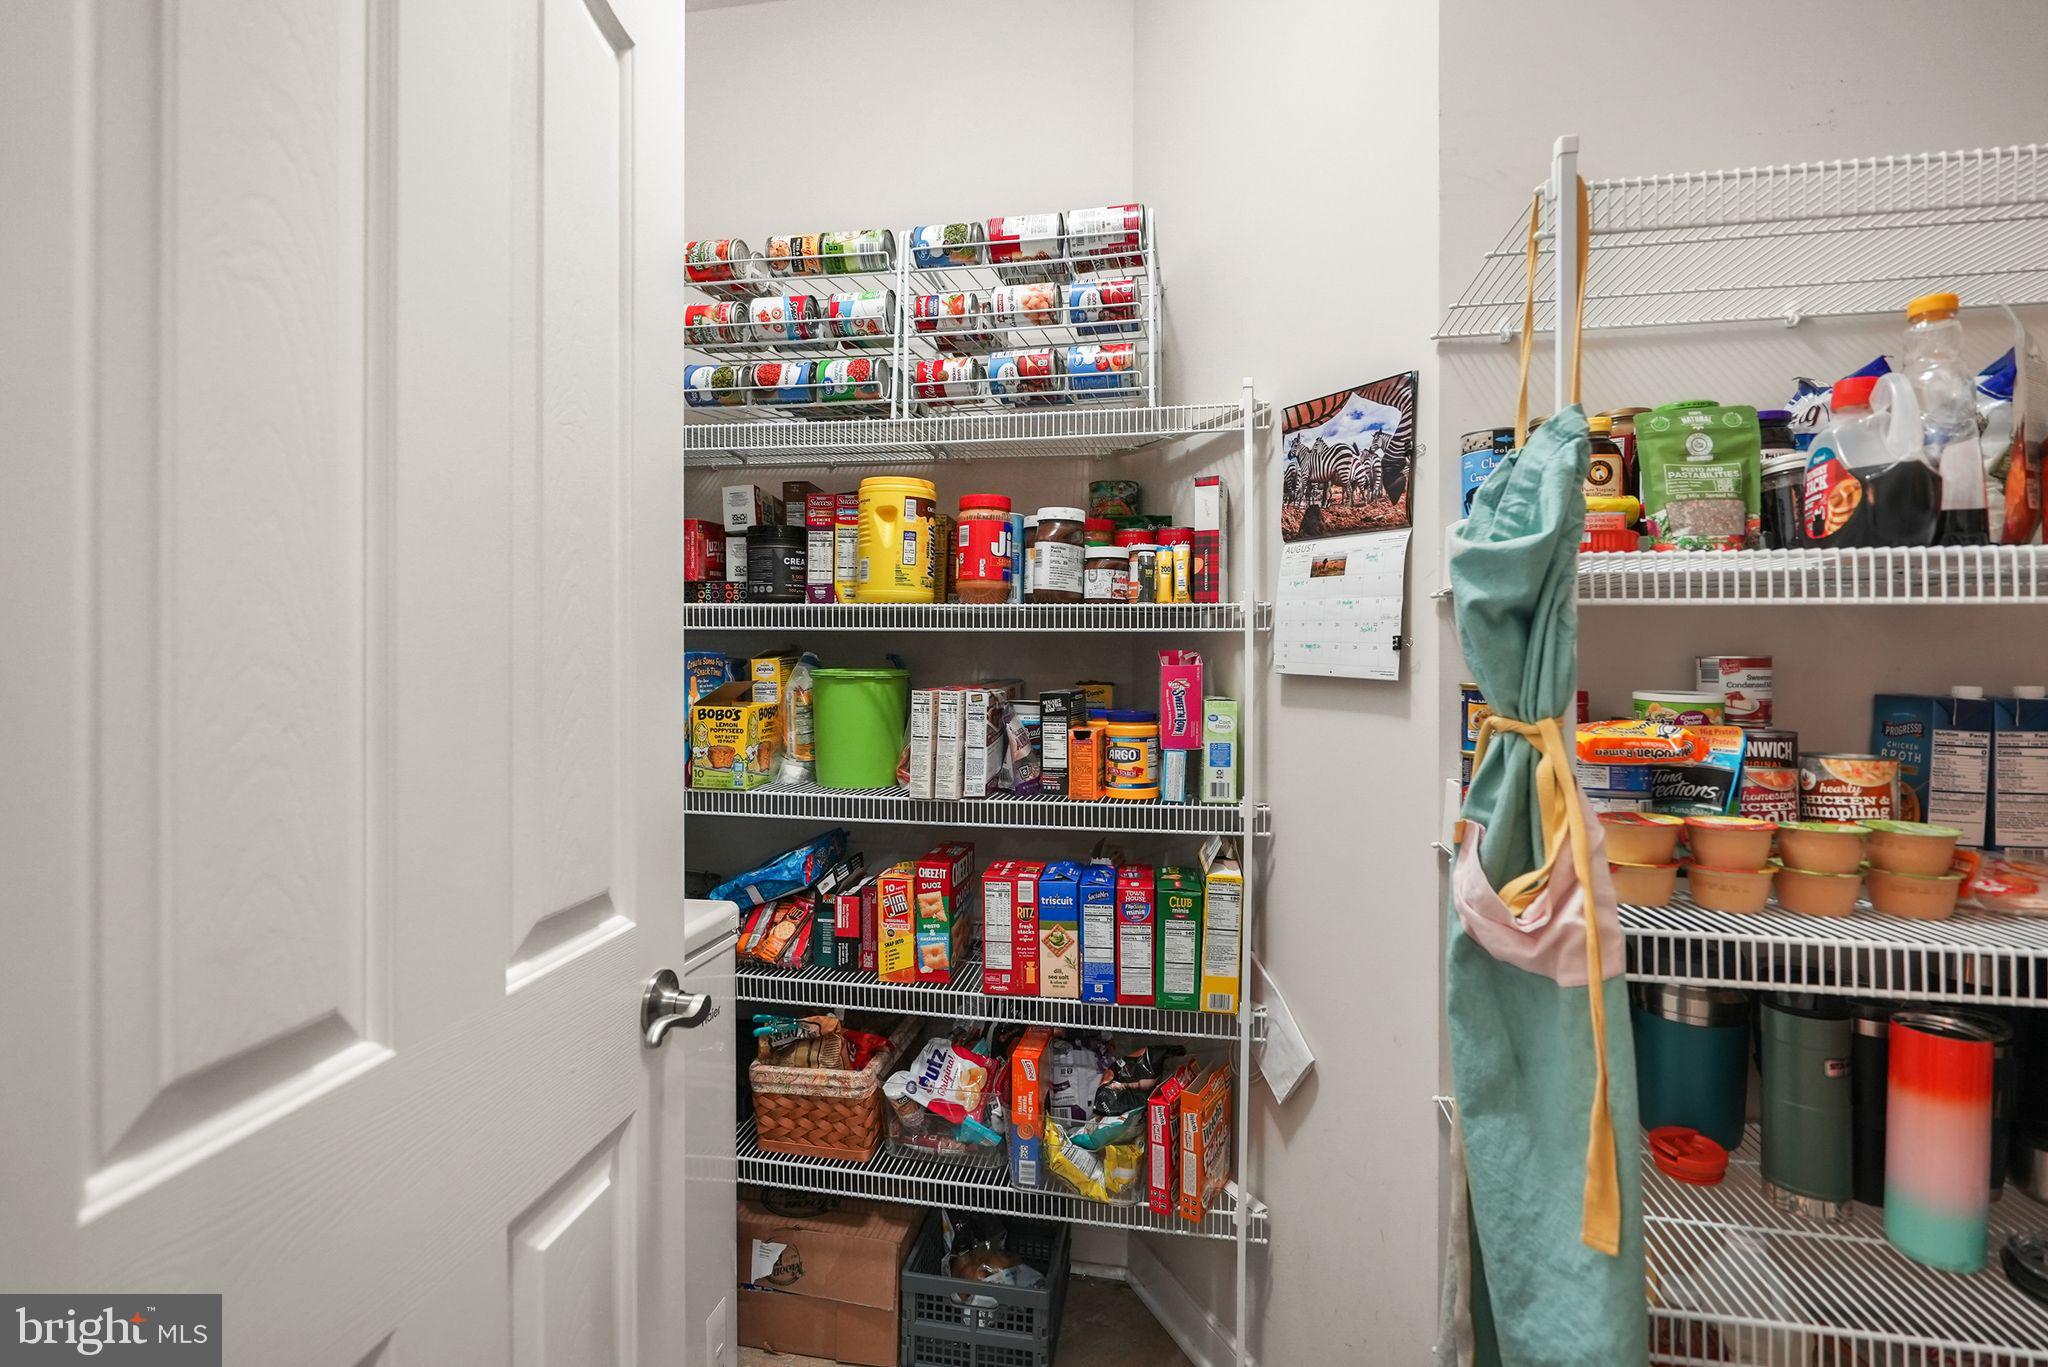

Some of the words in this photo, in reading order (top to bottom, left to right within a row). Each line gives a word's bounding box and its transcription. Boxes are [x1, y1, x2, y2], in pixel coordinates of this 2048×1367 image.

[1668, 470, 1740, 479] PASTABILITIES
[809, 498, 833, 507] Success
[990, 530, 1012, 557] Ji
[1285, 544, 1316, 554] AUGUST
[927, 524, 936, 577] Nesquik
[697, 708, 742, 721] BOBO'S
[1884, 723, 1923, 736] PROGRESSO
[1746, 741, 1792, 761] NWICH
[1886, 740, 1919, 750] CHICKEN
[1108, 749, 1137, 761] ARGO
[1595, 749, 1633, 758] Ramen
[1637, 748, 1692, 759] Maruchan
[694, 770, 705, 778] 10
[1651, 769, 1682, 785] Tuna
[1651, 780, 1720, 799] reations
[1819, 783, 1862, 796] hearty
[918, 867, 947, 880] CHEEZ-IT
[884, 884, 895, 893] 10
[1040, 896, 1073, 905] triscuit
[1087, 891, 1109, 902] Sociables
[1169, 896, 1192, 908] CLUB
[788, 907, 804, 919] RITZ
[1017, 907, 1035, 919] RITZ
